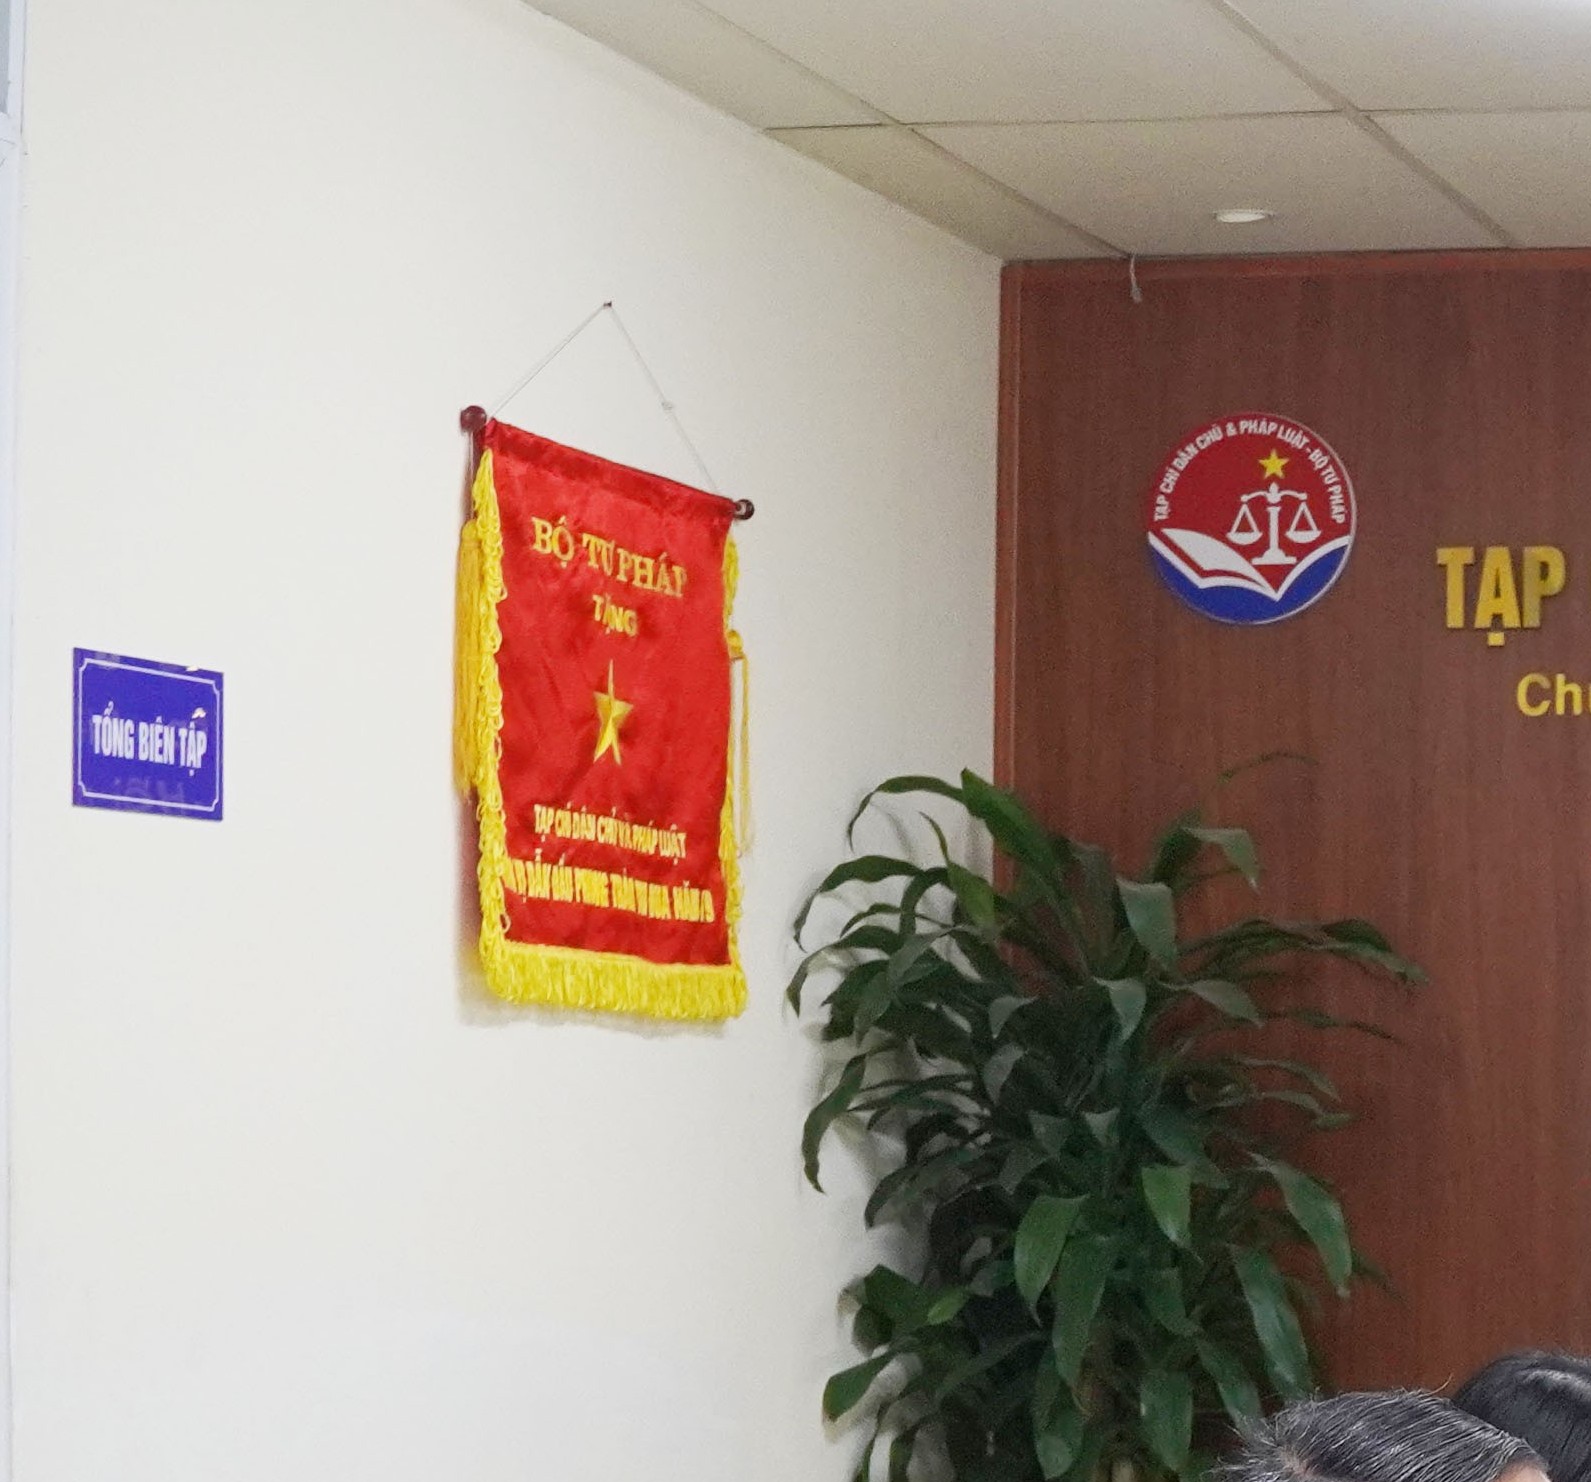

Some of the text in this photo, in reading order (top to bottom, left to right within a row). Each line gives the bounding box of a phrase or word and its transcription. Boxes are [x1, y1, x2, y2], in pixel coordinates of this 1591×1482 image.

[531, 515, 688, 598] BỘ TƯ PHÁP
[1436, 545, 1566, 646] TẠP
[592, 593, 639, 637] TẶNG
[92, 701, 208, 777] TỔNG BIÊN TẬP
